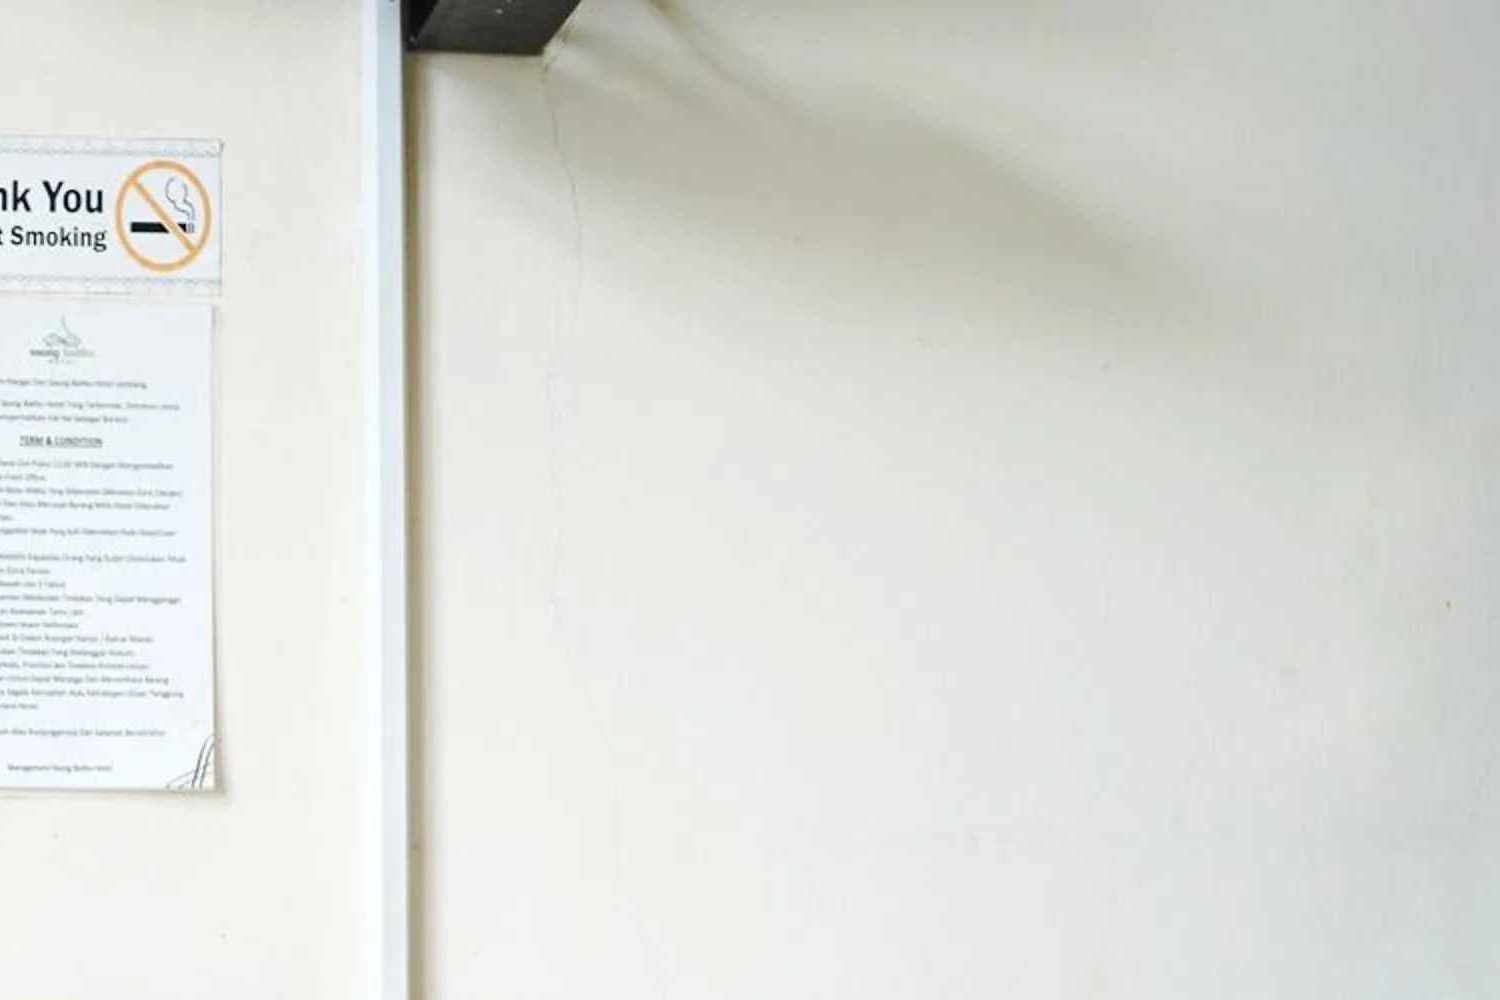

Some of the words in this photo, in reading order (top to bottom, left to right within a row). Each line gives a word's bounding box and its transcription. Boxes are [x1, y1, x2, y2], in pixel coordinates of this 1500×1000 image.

[43, 180, 104, 213] You
[11, 225, 107, 252] Smoking
[19, 435, 44, 446] TERM
[46, 435, 53, 446] &
[54, 436, 103, 448] CONDITION
